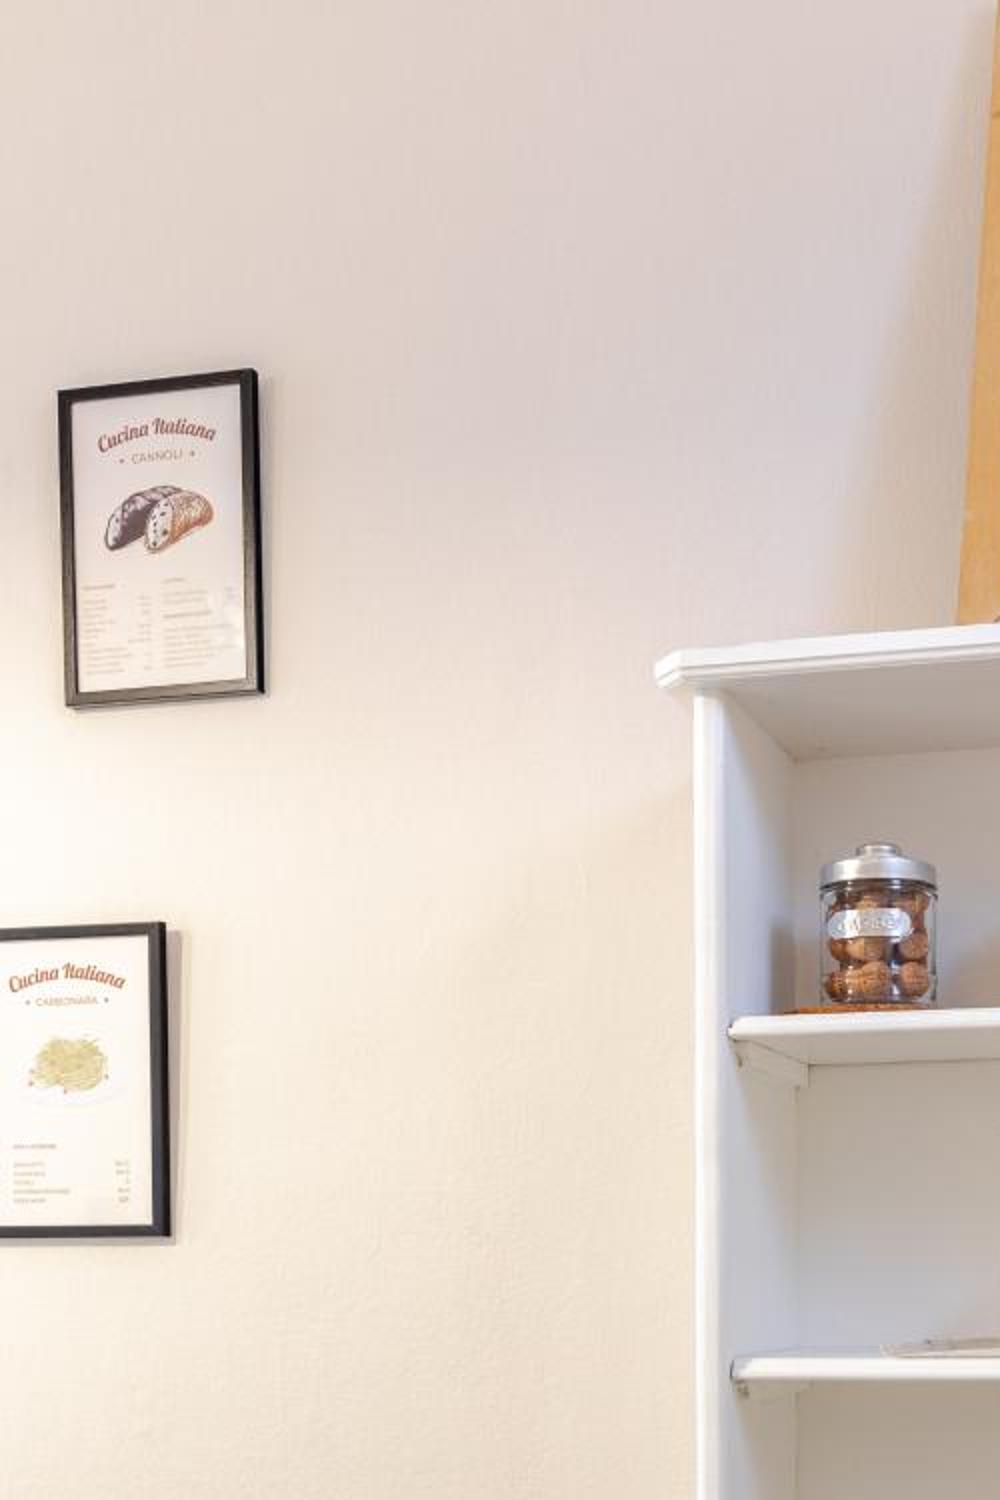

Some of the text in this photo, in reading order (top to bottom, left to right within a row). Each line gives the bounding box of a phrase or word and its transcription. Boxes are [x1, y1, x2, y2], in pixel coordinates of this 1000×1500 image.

[97, 417, 217, 453] Cucina Italiana
[131, 448, 184, 465] CANNOLI
[8, 961, 127, 993] Cucina Italiana
